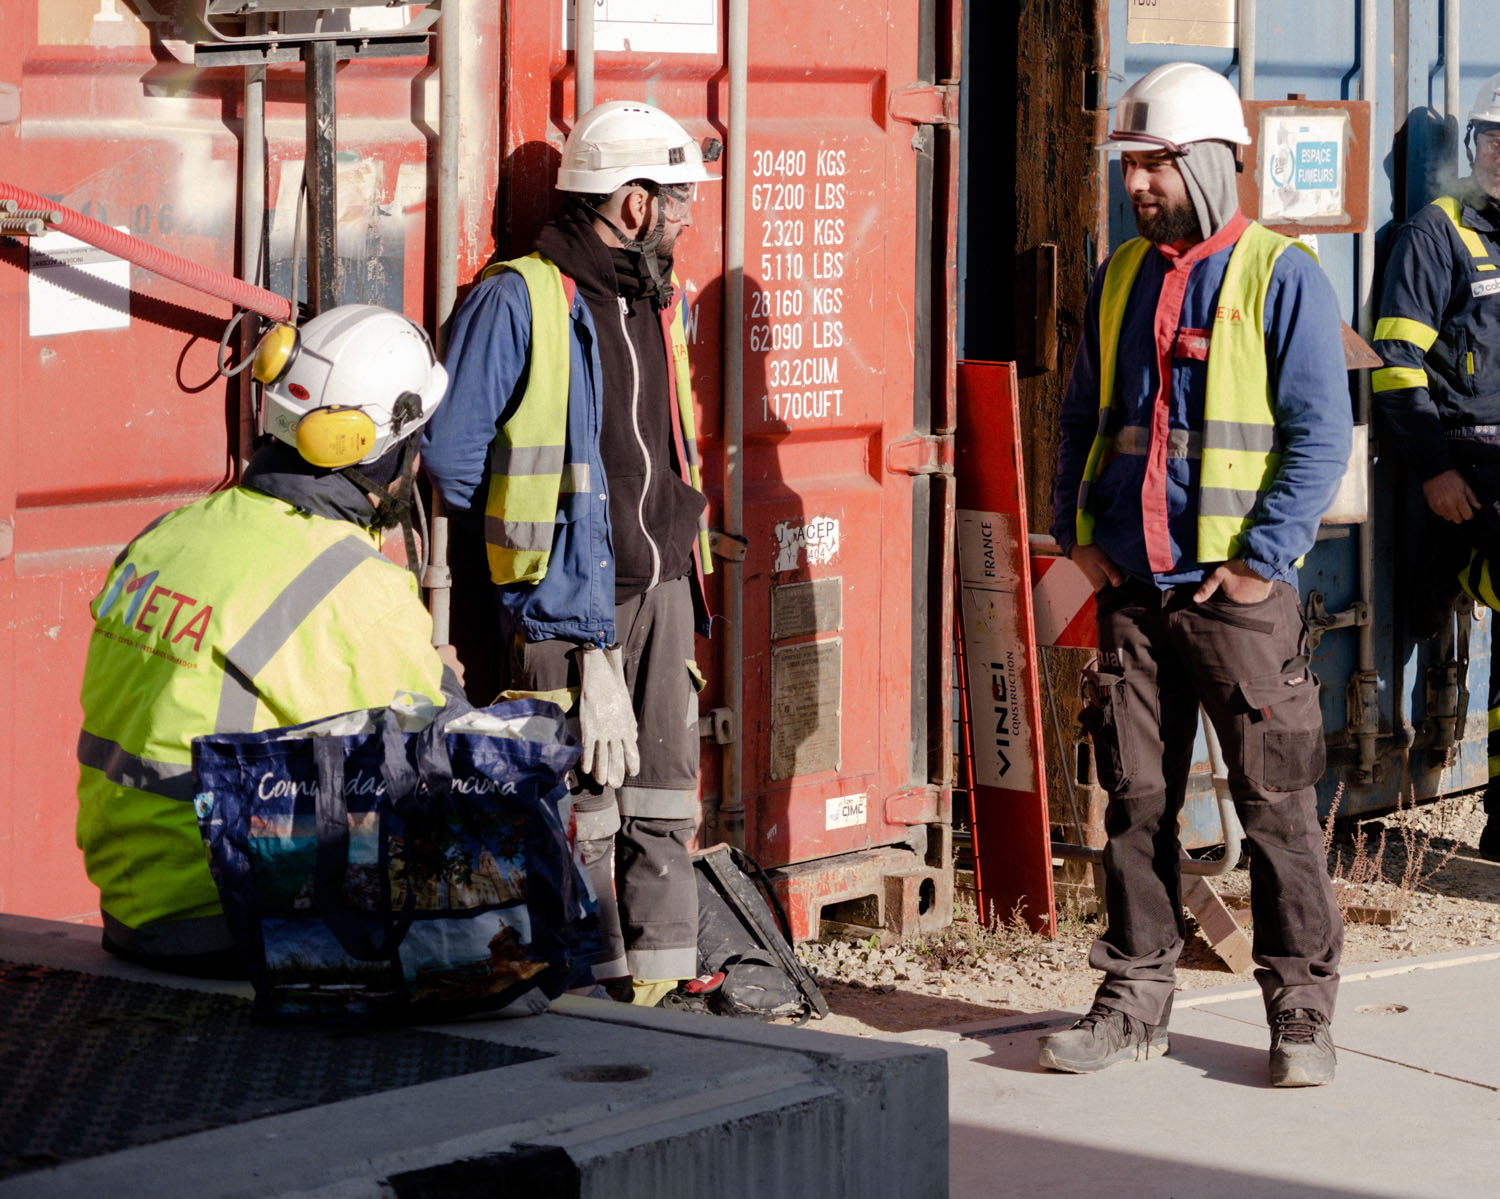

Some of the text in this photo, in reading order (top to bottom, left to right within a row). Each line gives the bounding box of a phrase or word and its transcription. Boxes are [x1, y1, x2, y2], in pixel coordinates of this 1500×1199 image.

[753, 149, 846, 177] 30.480 KGS
[1301, 148, 1331, 163] ESPACE
[752, 183, 845, 211] 67.200 LBS
[762, 219, 845, 247] 2.320 KGS
[761, 252, 844, 281] 5.110 LBS
[751, 287, 843, 318] 28.160 KGS
[1216, 305, 1241, 322] ETA
[750, 321, 843, 352] 62.090 LBS
[981, 520, 996, 579] FRANCE
[97, 562, 213, 653] META
[1005, 650, 1021, 737] CONSTRUCTION
[990, 661, 1011, 778] VINCI
